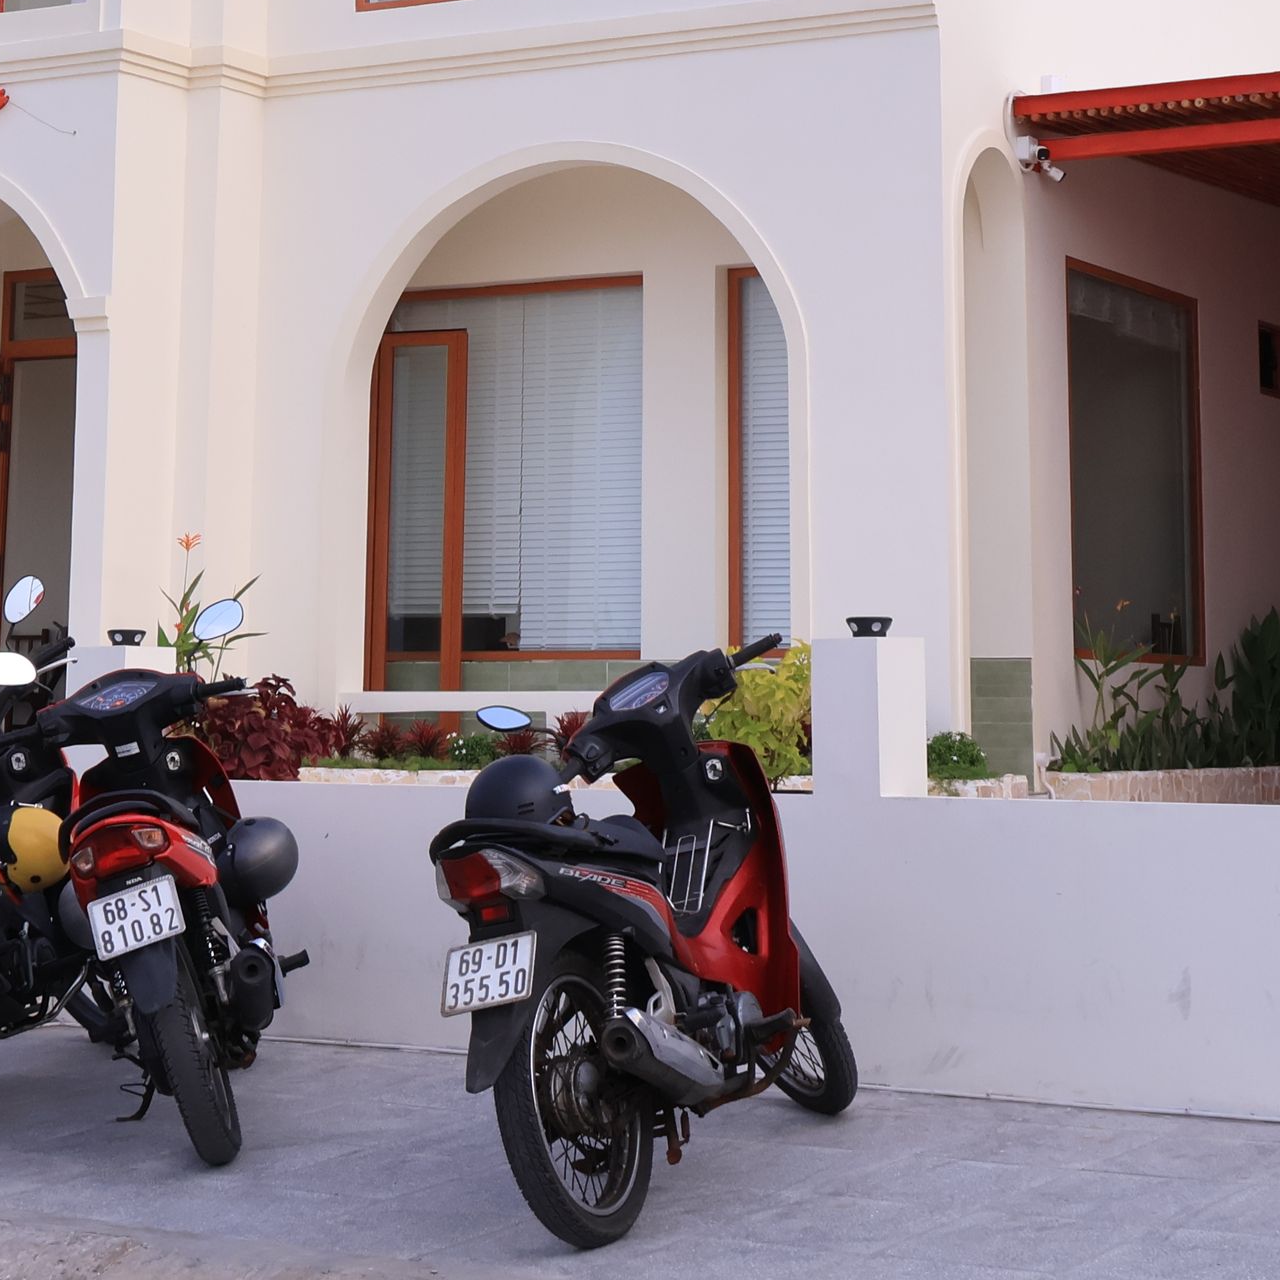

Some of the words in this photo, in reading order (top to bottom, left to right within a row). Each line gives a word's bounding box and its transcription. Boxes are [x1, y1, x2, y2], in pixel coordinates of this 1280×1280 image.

[559, 866, 626, 888] BLADE
[102, 884, 162, 926] 68-S1
[100, 907, 179, 954] 810.82
[458, 938, 519, 977] 69-D1
[447, 967, 527, 1010] 355.50
